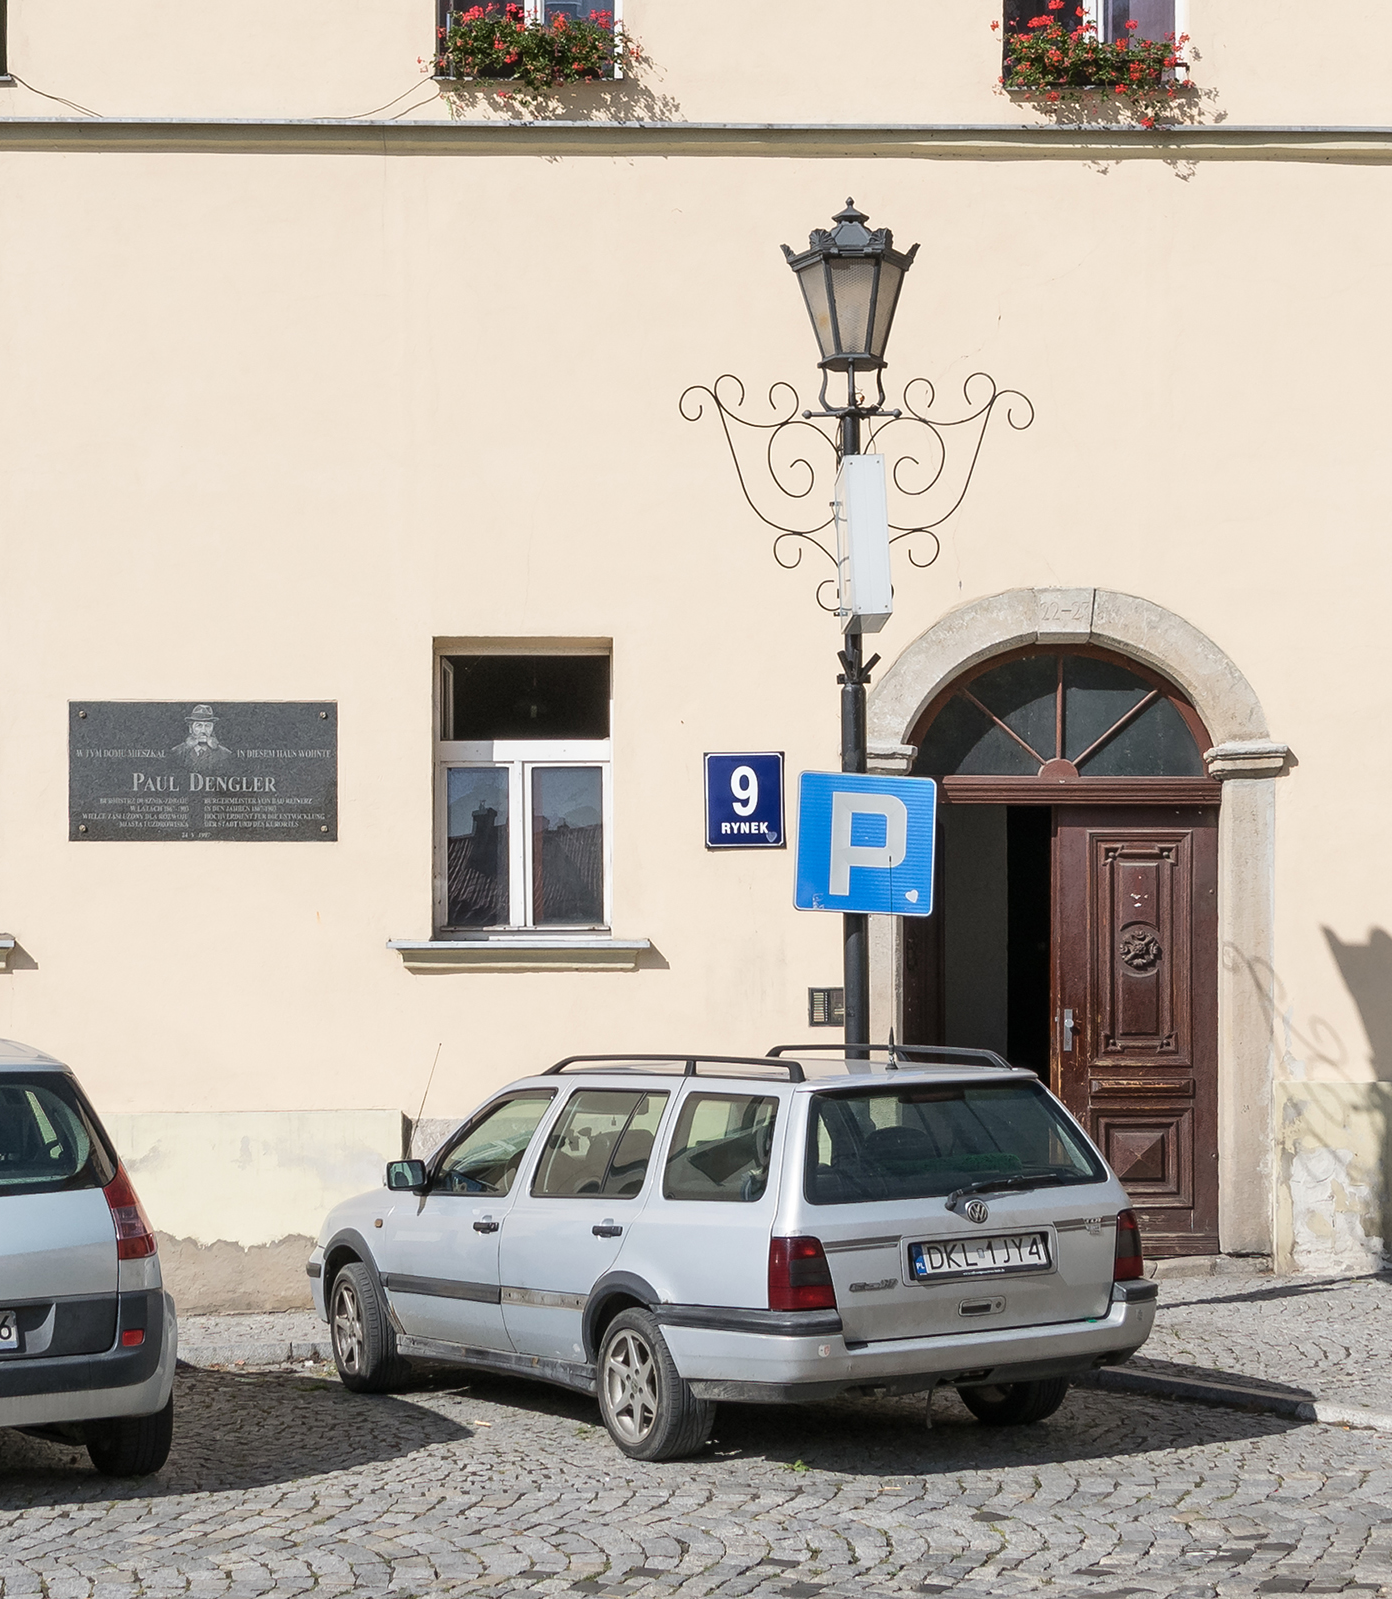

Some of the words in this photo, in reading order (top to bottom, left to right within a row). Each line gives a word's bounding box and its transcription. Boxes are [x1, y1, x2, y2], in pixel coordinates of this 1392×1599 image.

[237, 749, 245, 758] IN
[248, 749, 275, 758] DIESEM
[276, 749, 297, 758] HAUS
[298, 749, 331, 758] WOHNTE
[132, 772, 180, 792] PAUL
[189, 772, 277, 792] DENGLER
[730, 765, 759, 817] 9
[721, 821, 769, 835] RYNEK
[829, 791, 908, 896] P
[916, 1261, 926, 1270] PL
[925, 1243, 978, 1271] DKL
[986, 1237, 1042, 1266] 1JY4
